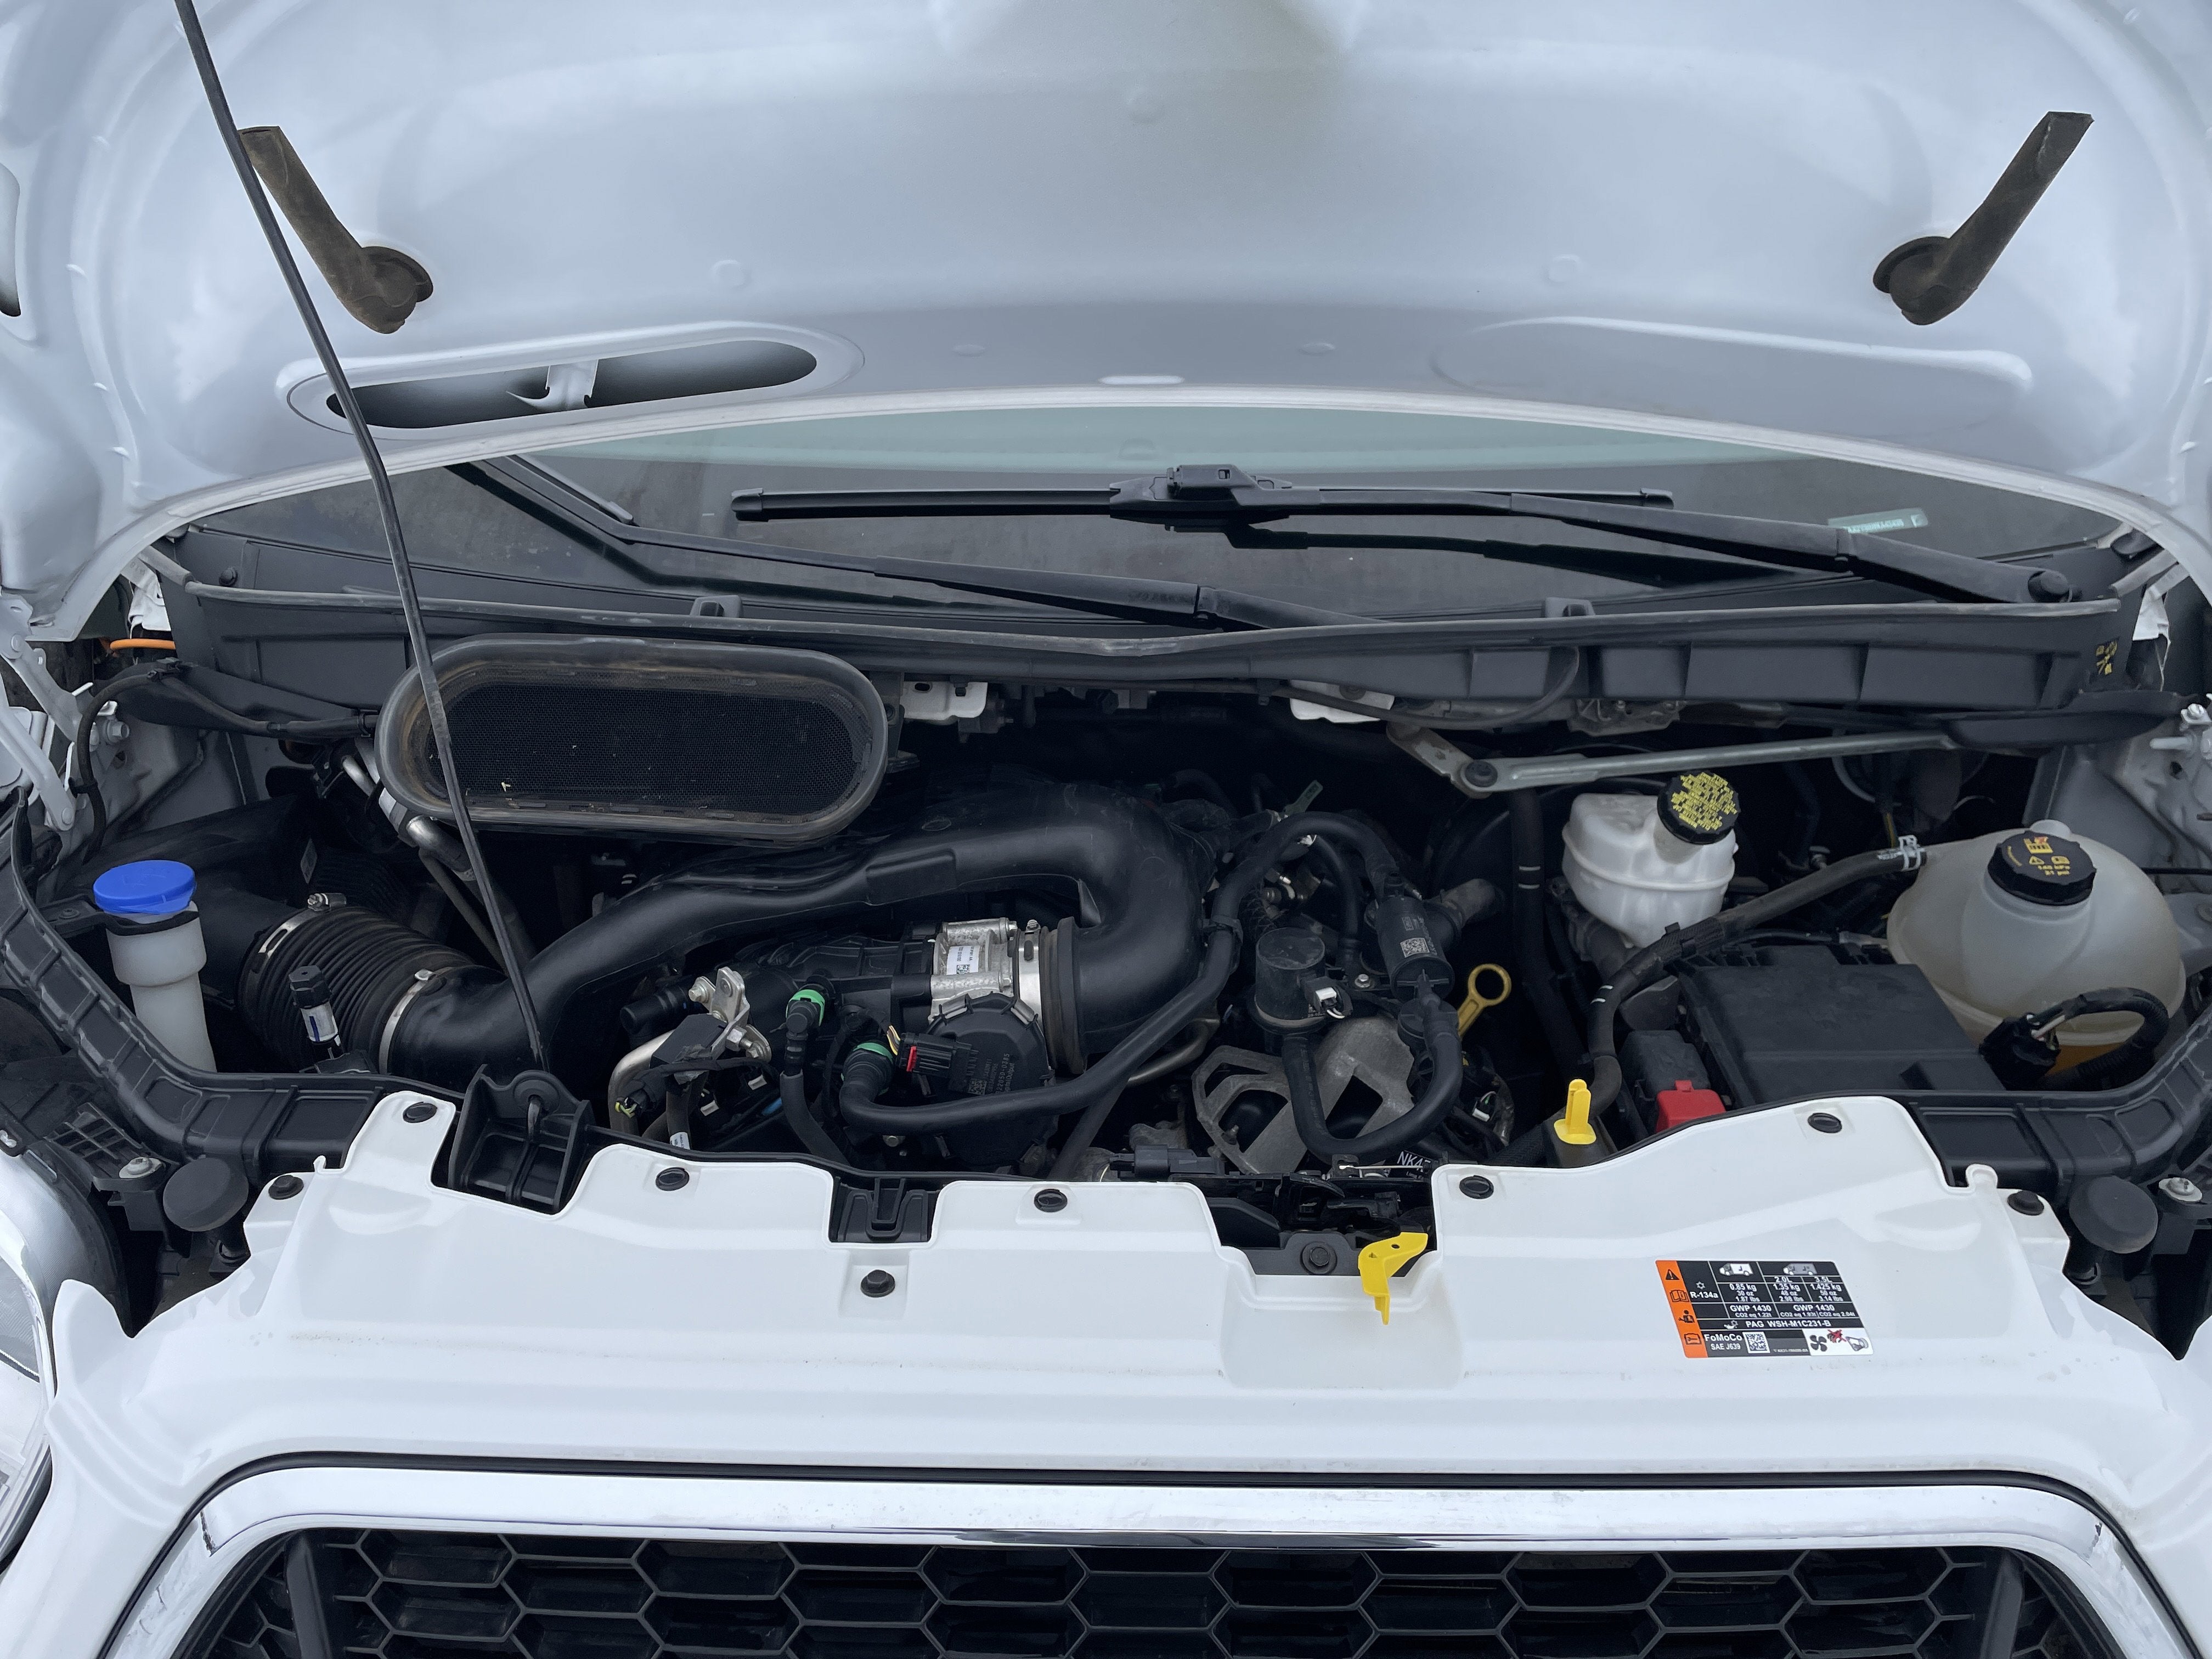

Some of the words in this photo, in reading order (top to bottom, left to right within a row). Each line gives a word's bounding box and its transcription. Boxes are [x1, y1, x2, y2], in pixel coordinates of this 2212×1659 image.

[1746, 1283, 1757, 1291] kg
[1790, 1283, 1801, 1291] kg
[1831, 1283, 1842, 1291] kg
